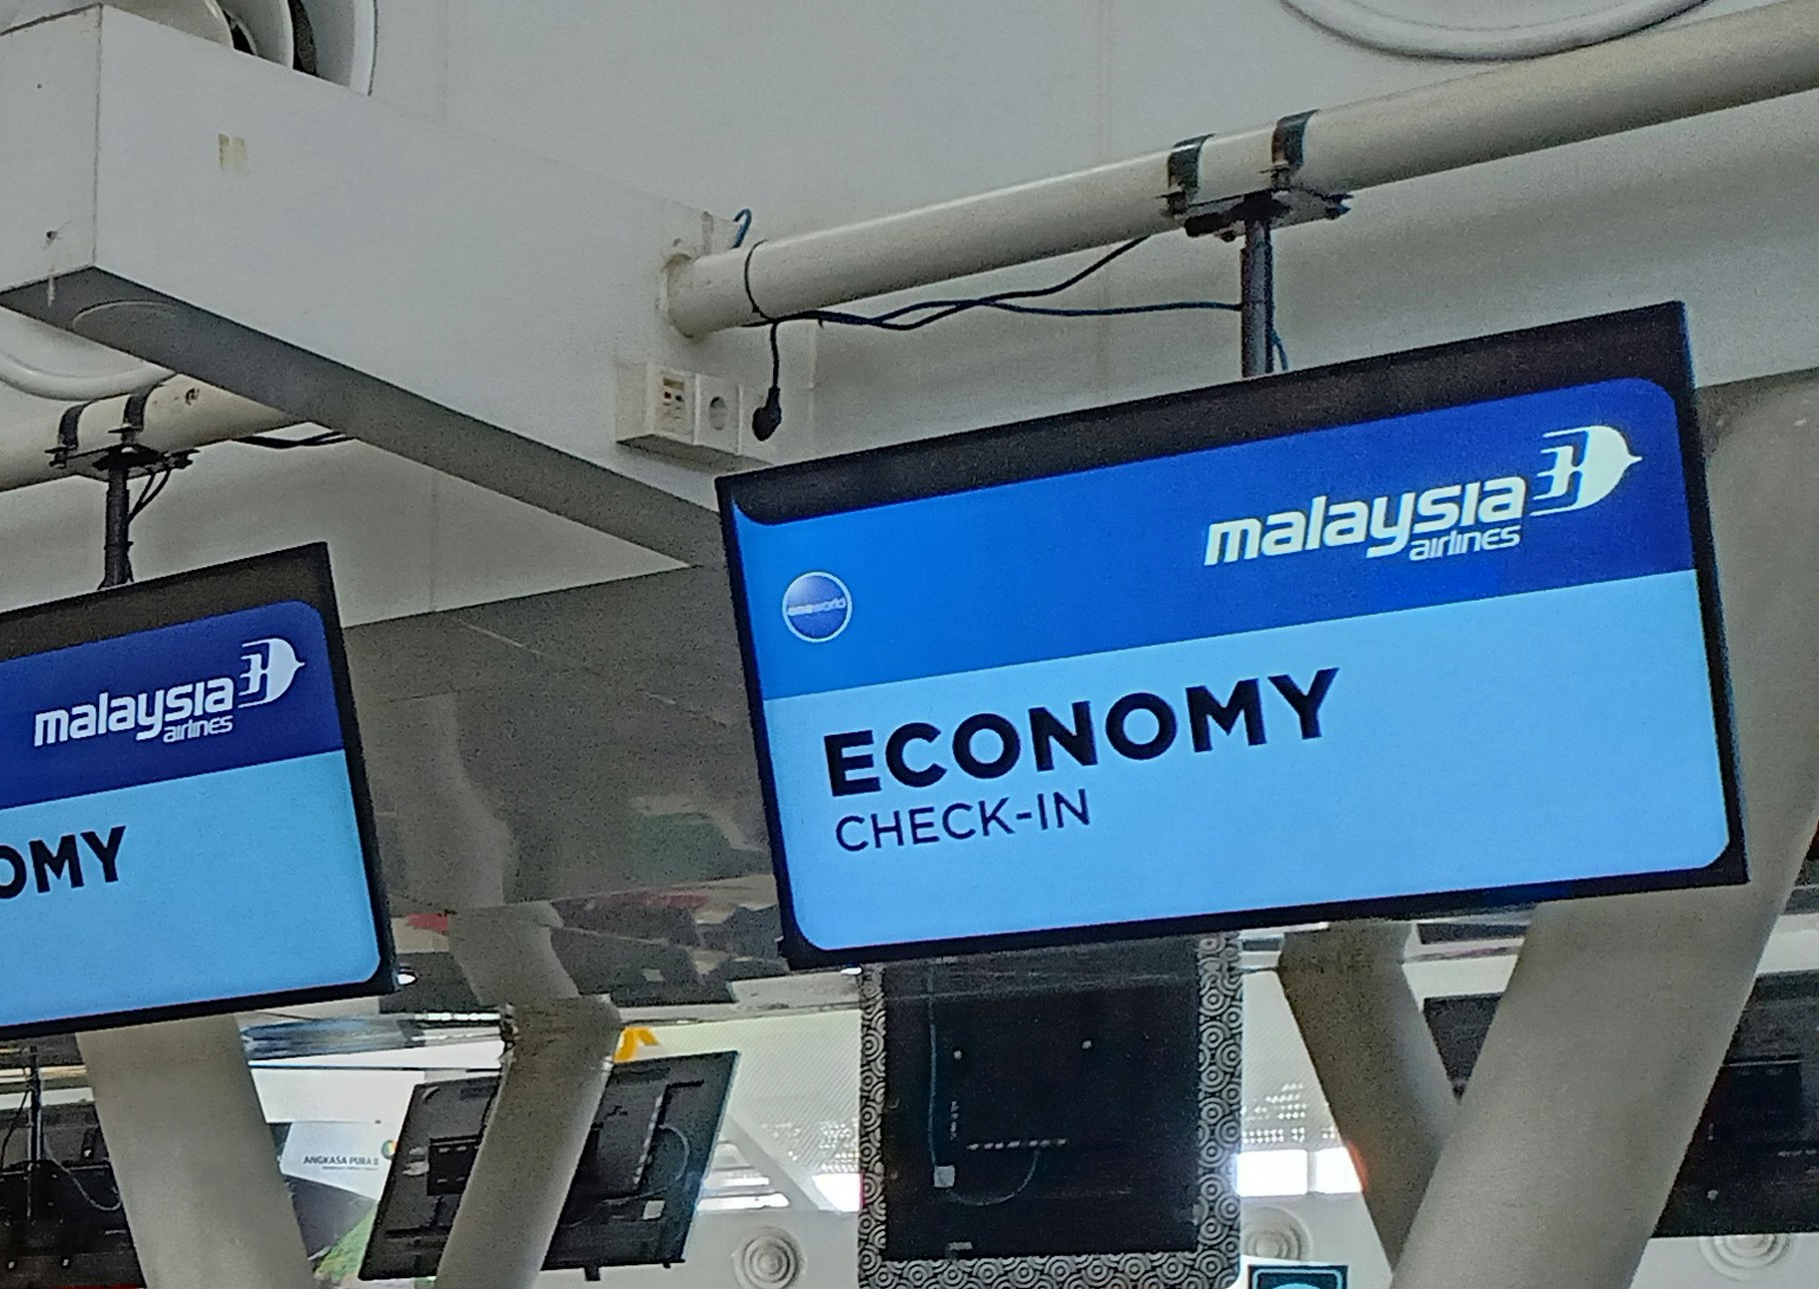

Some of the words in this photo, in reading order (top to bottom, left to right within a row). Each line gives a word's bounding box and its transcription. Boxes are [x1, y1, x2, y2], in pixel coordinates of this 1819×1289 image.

[1204, 473, 1527, 565] malaysia
[1409, 524, 1521, 562] airlines
[33, 674, 235, 747] malaysia
[163, 714, 233, 743] airlines
[823, 667, 1340, 797] ECONOMY
[834, 788, 1092, 852] CHECK-IN
